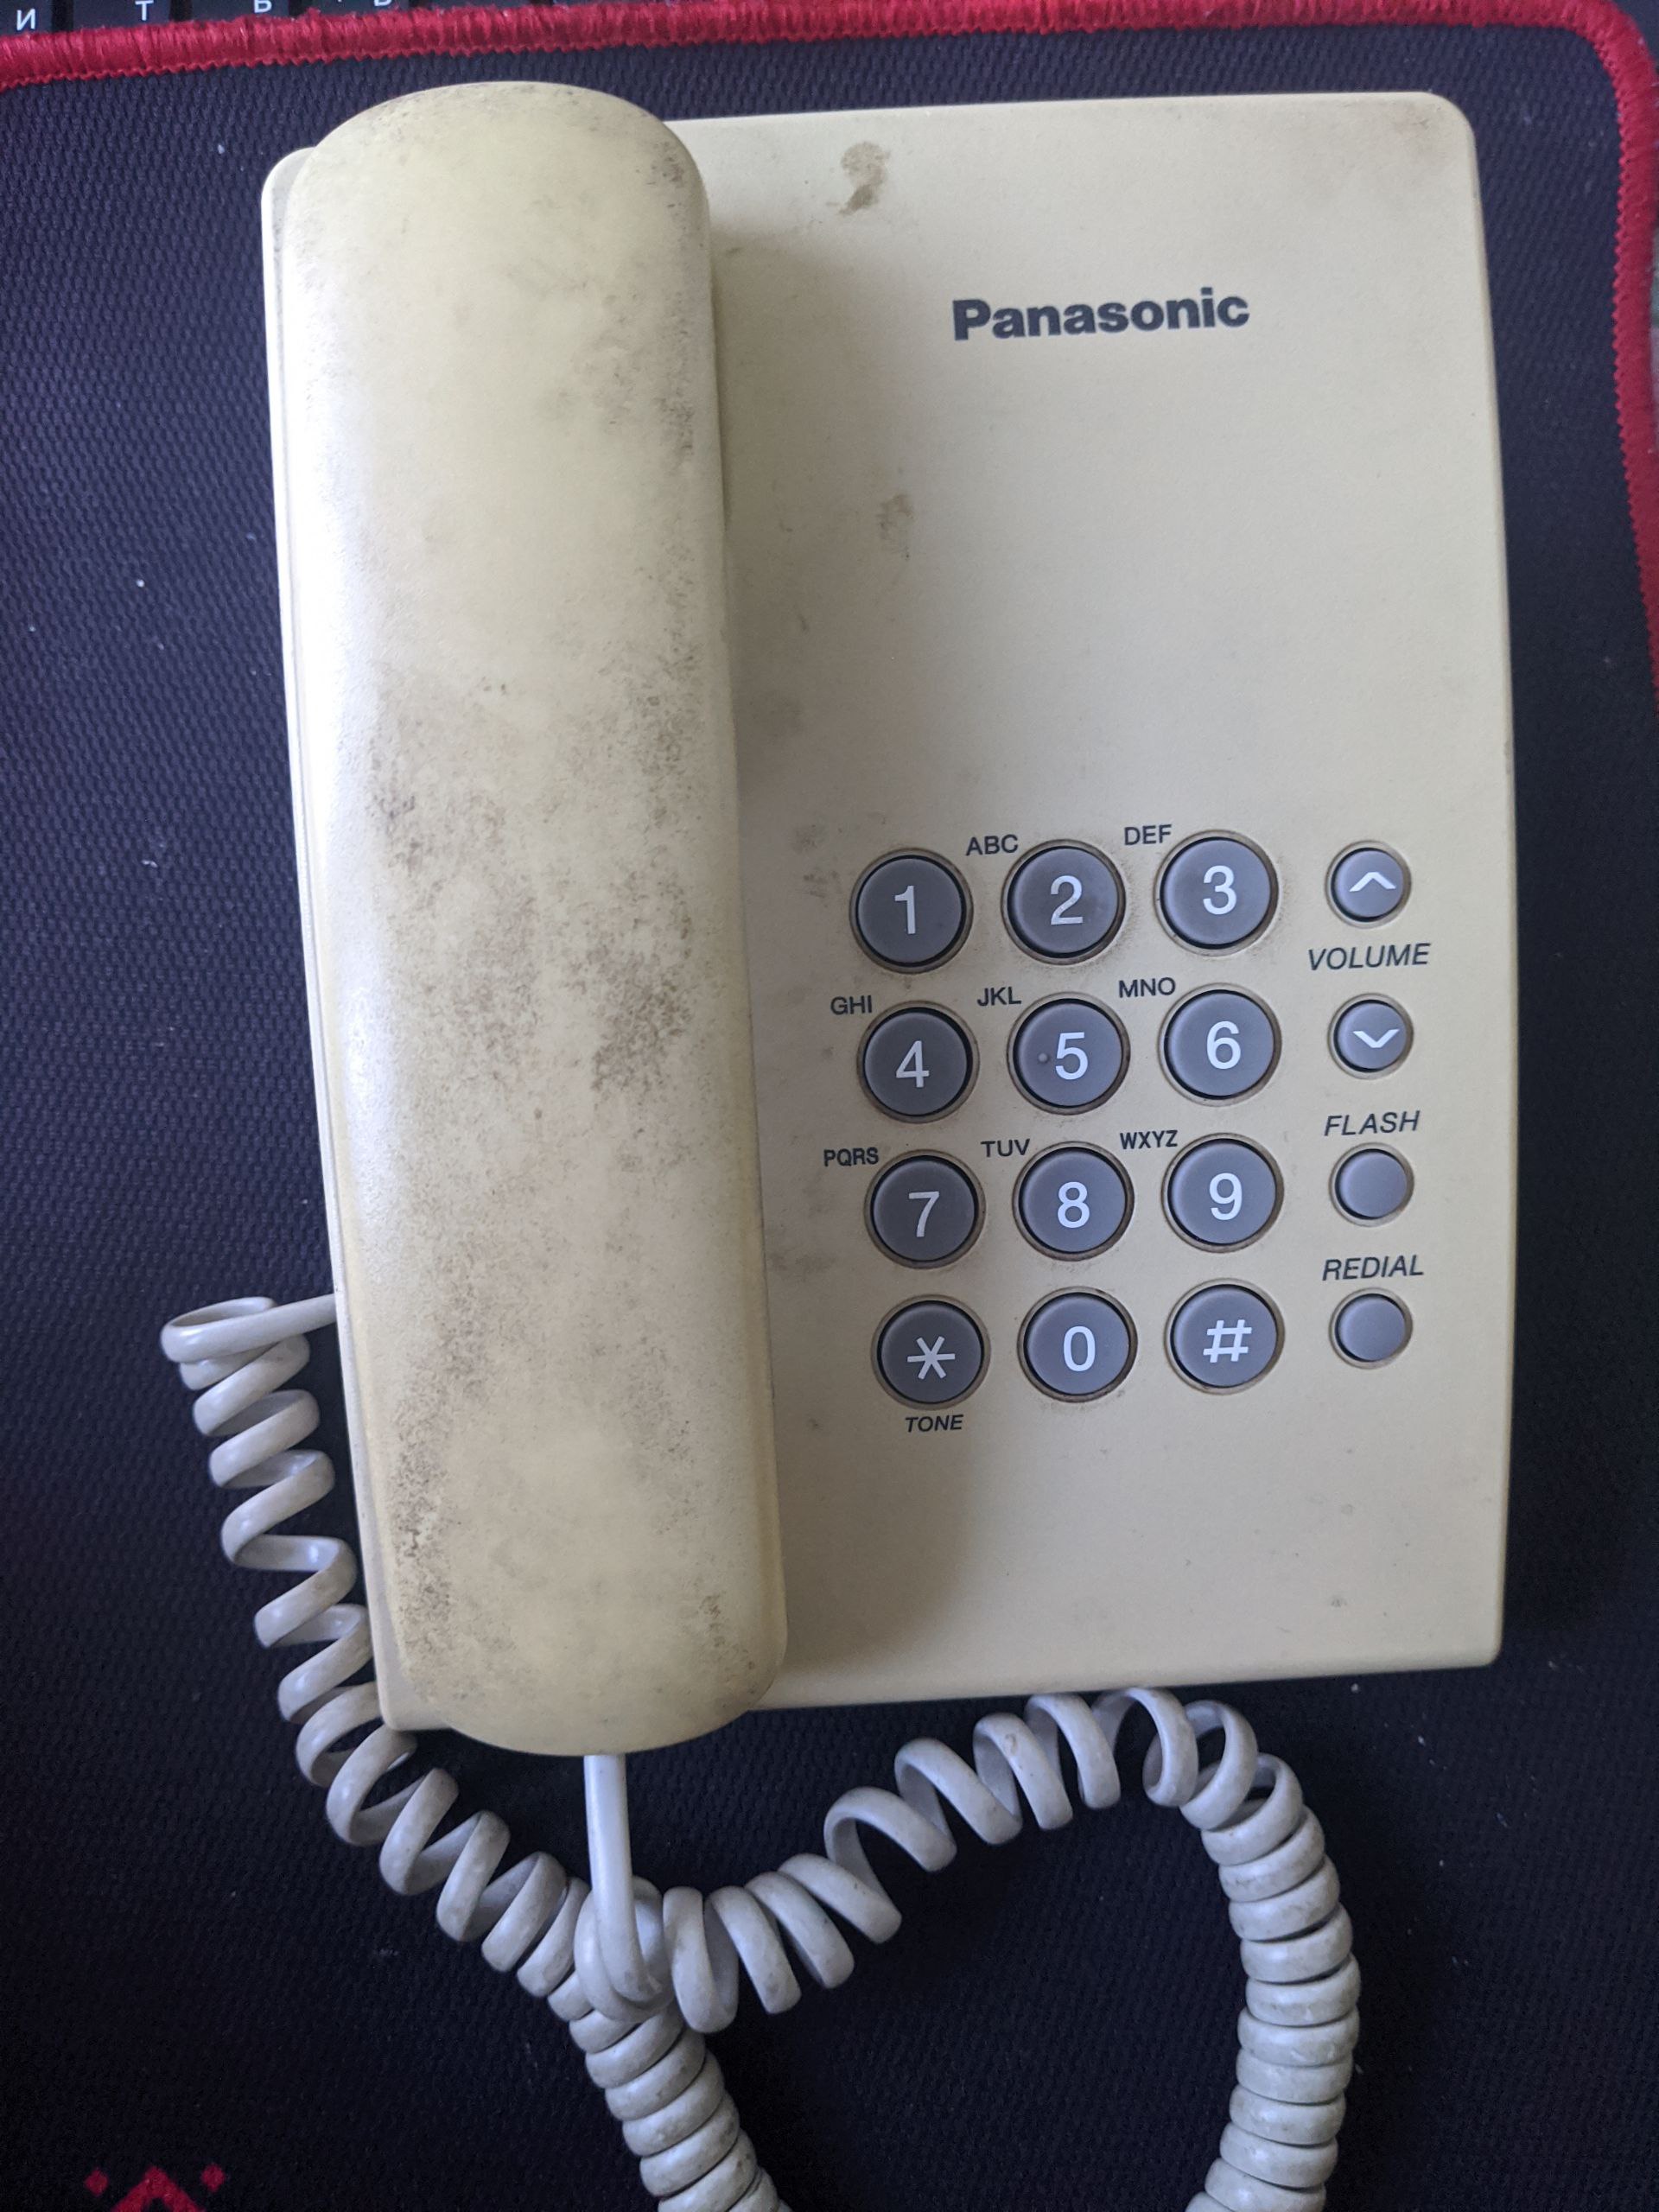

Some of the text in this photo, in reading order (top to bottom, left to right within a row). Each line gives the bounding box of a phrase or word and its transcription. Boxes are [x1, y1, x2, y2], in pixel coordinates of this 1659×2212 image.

[16, 8, 36, 31] И
[952, 287, 1250, 340] Panasonic
[965, 834, 1019, 856] ABC
[1124, 823, 1172, 846] DEF
[1051, 875, 1083, 925] 2
[1203, 865, 1236, 915] 3
[894, 885, 916, 935] 1
[1308, 943, 1432, 971] VOLUME
[976, 986, 1022, 1007] JKL
[1118, 976, 1176, 999] MNO
[830, 995, 873, 1015] GHI
[1055, 1032, 1089, 1080] 5
[1206, 1020, 1241, 1070] 6
[896, 1040, 930, 1088] 4
[1324, 1110, 1421, 1136] FLASH
[980, 1138, 1031, 1158] TUV
[1119, 1129, 1179, 1150] WXYZ
[823, 1147, 880, 1167] PQRS
[1057, 1181, 1090, 1229] 8
[1209, 1173, 1243, 1221] 9
[908, 1191, 940, 1237] 7
[1322, 1255, 1424, 1281] REDIAL
[1063, 1325, 1096, 1372] 0
[1203, 1319, 1253, 1363] #
[905, 1414, 964, 1433] TONE
